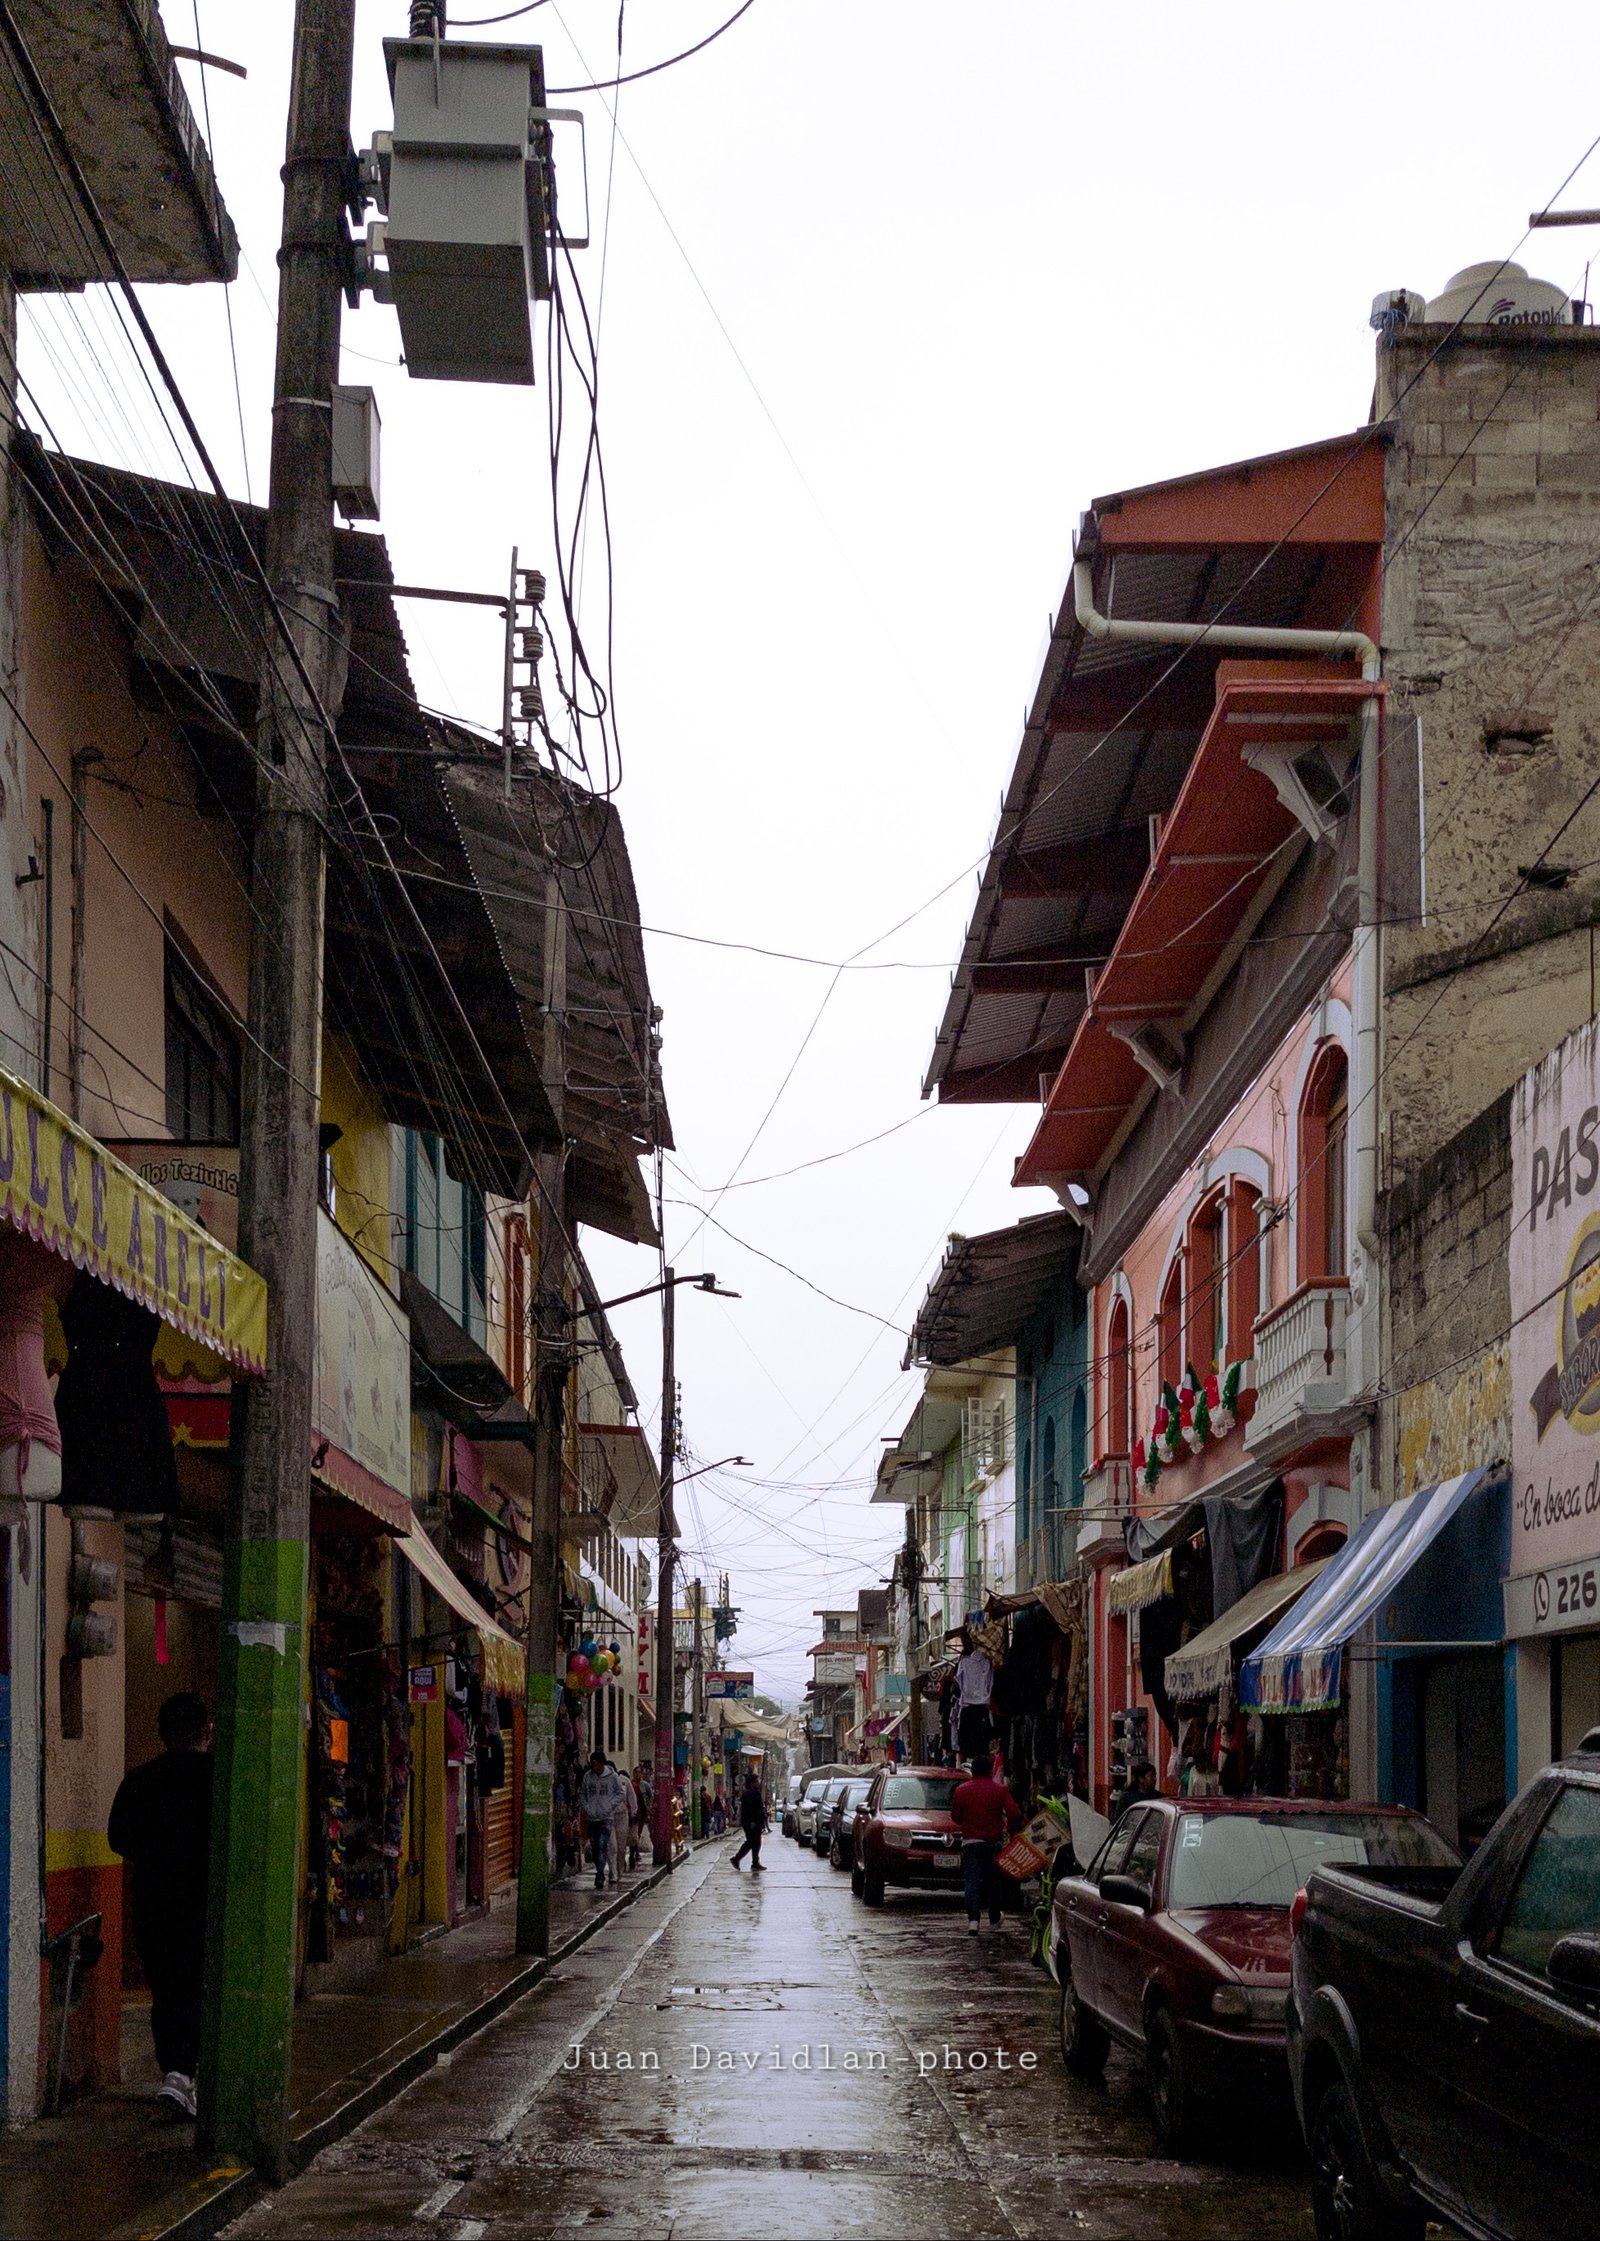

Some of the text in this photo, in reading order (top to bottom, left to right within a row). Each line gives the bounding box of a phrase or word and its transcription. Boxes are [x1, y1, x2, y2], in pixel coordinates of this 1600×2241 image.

[138, 1163, 168, 1185] llos
[1529, 1105, 1599, 1232] PAS
[127, 1194, 227, 1331] ARELI
[1544, 1476, 1582, 1526] boca
[1585, 1460, 1600, 1514] d
[1557, 1570, 1598, 1614] 226
[998, 1857, 1021, 1877] CHIP
